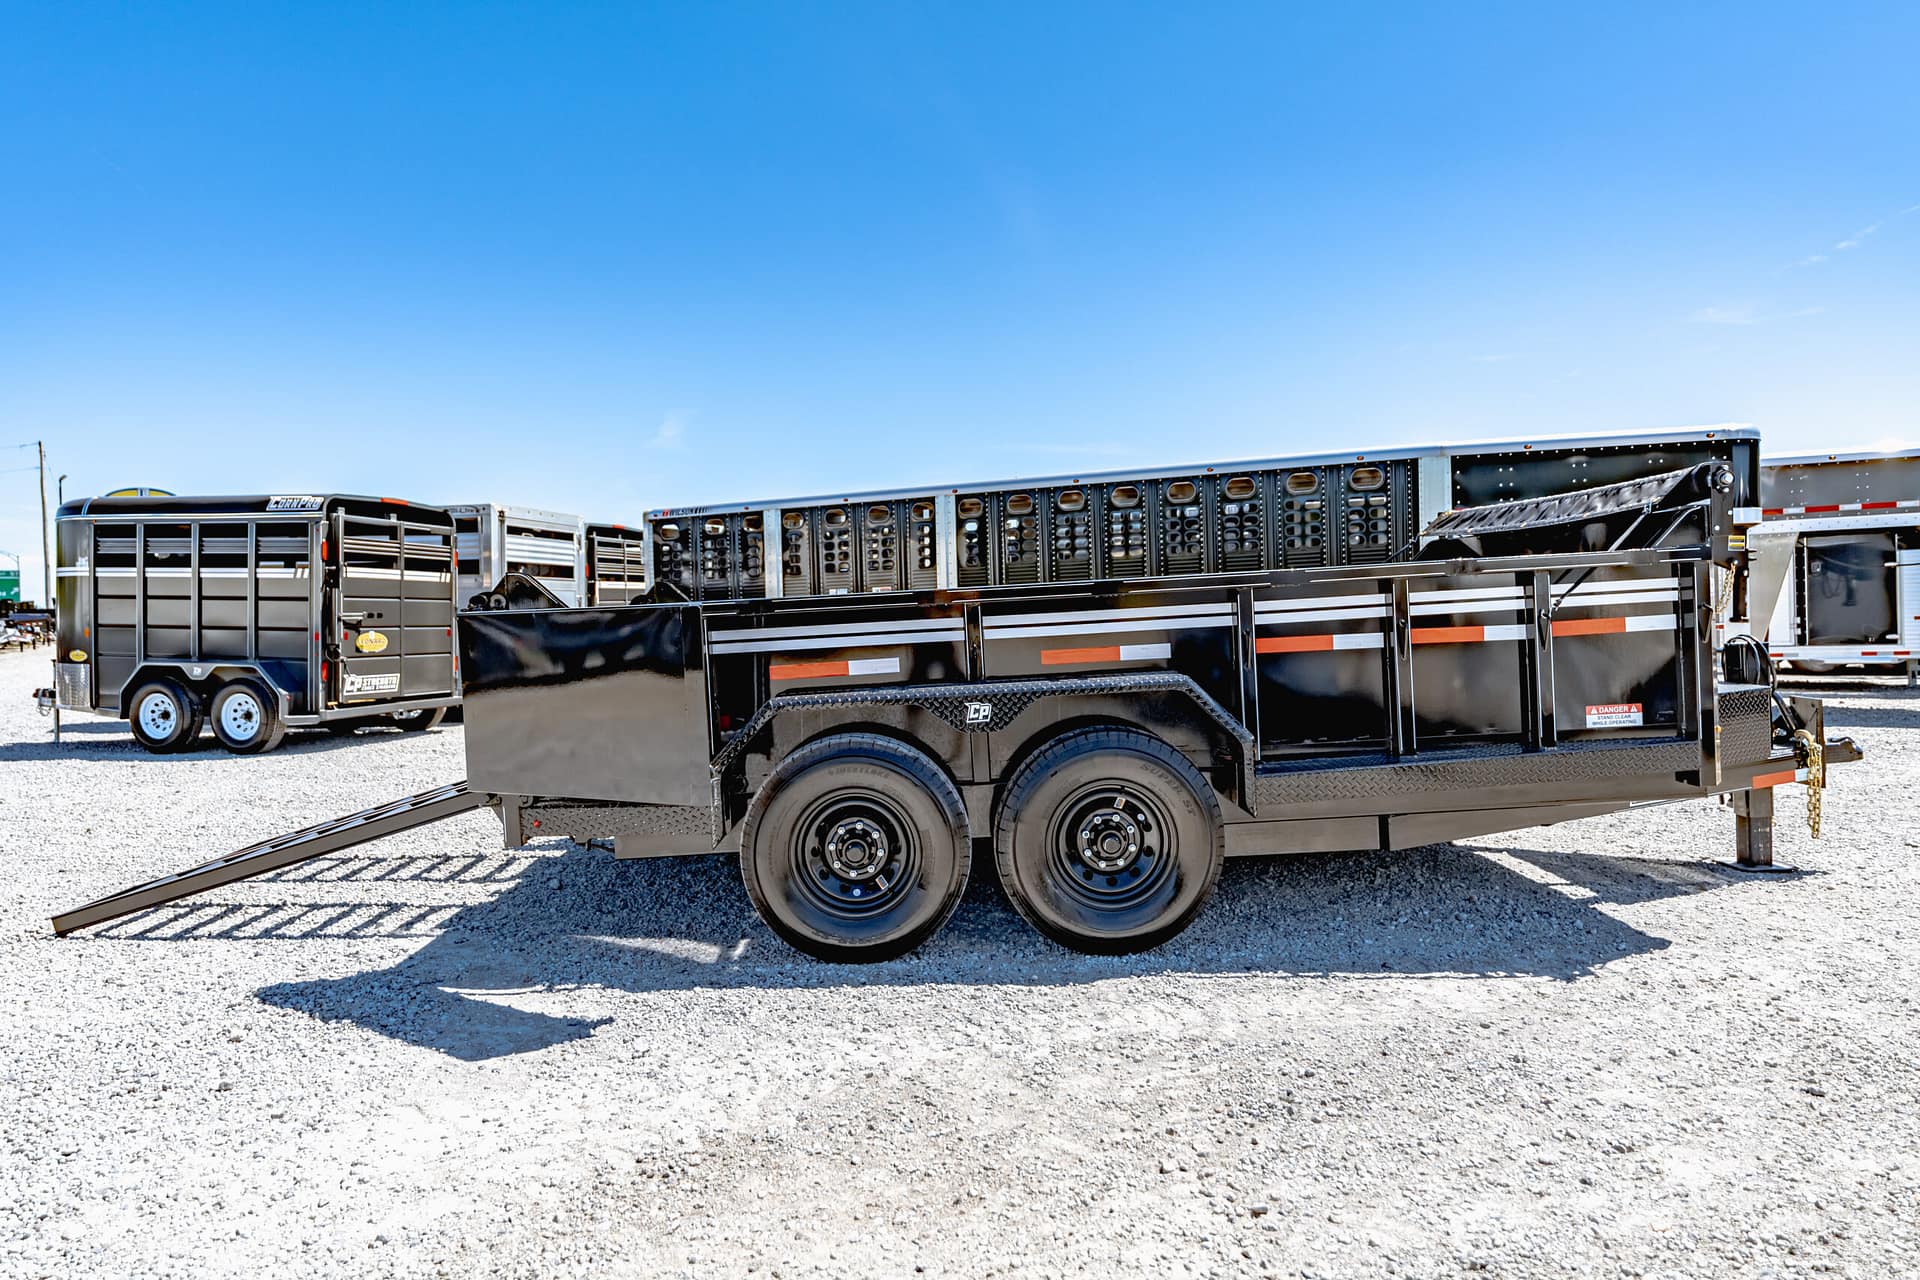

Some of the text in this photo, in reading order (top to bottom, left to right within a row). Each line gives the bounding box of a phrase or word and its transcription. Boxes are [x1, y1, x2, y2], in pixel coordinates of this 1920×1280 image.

[970, 704, 990, 720] CP
[1599, 705, 1629, 714] DANGER
[1140, 763, 1183, 795] SUPER
